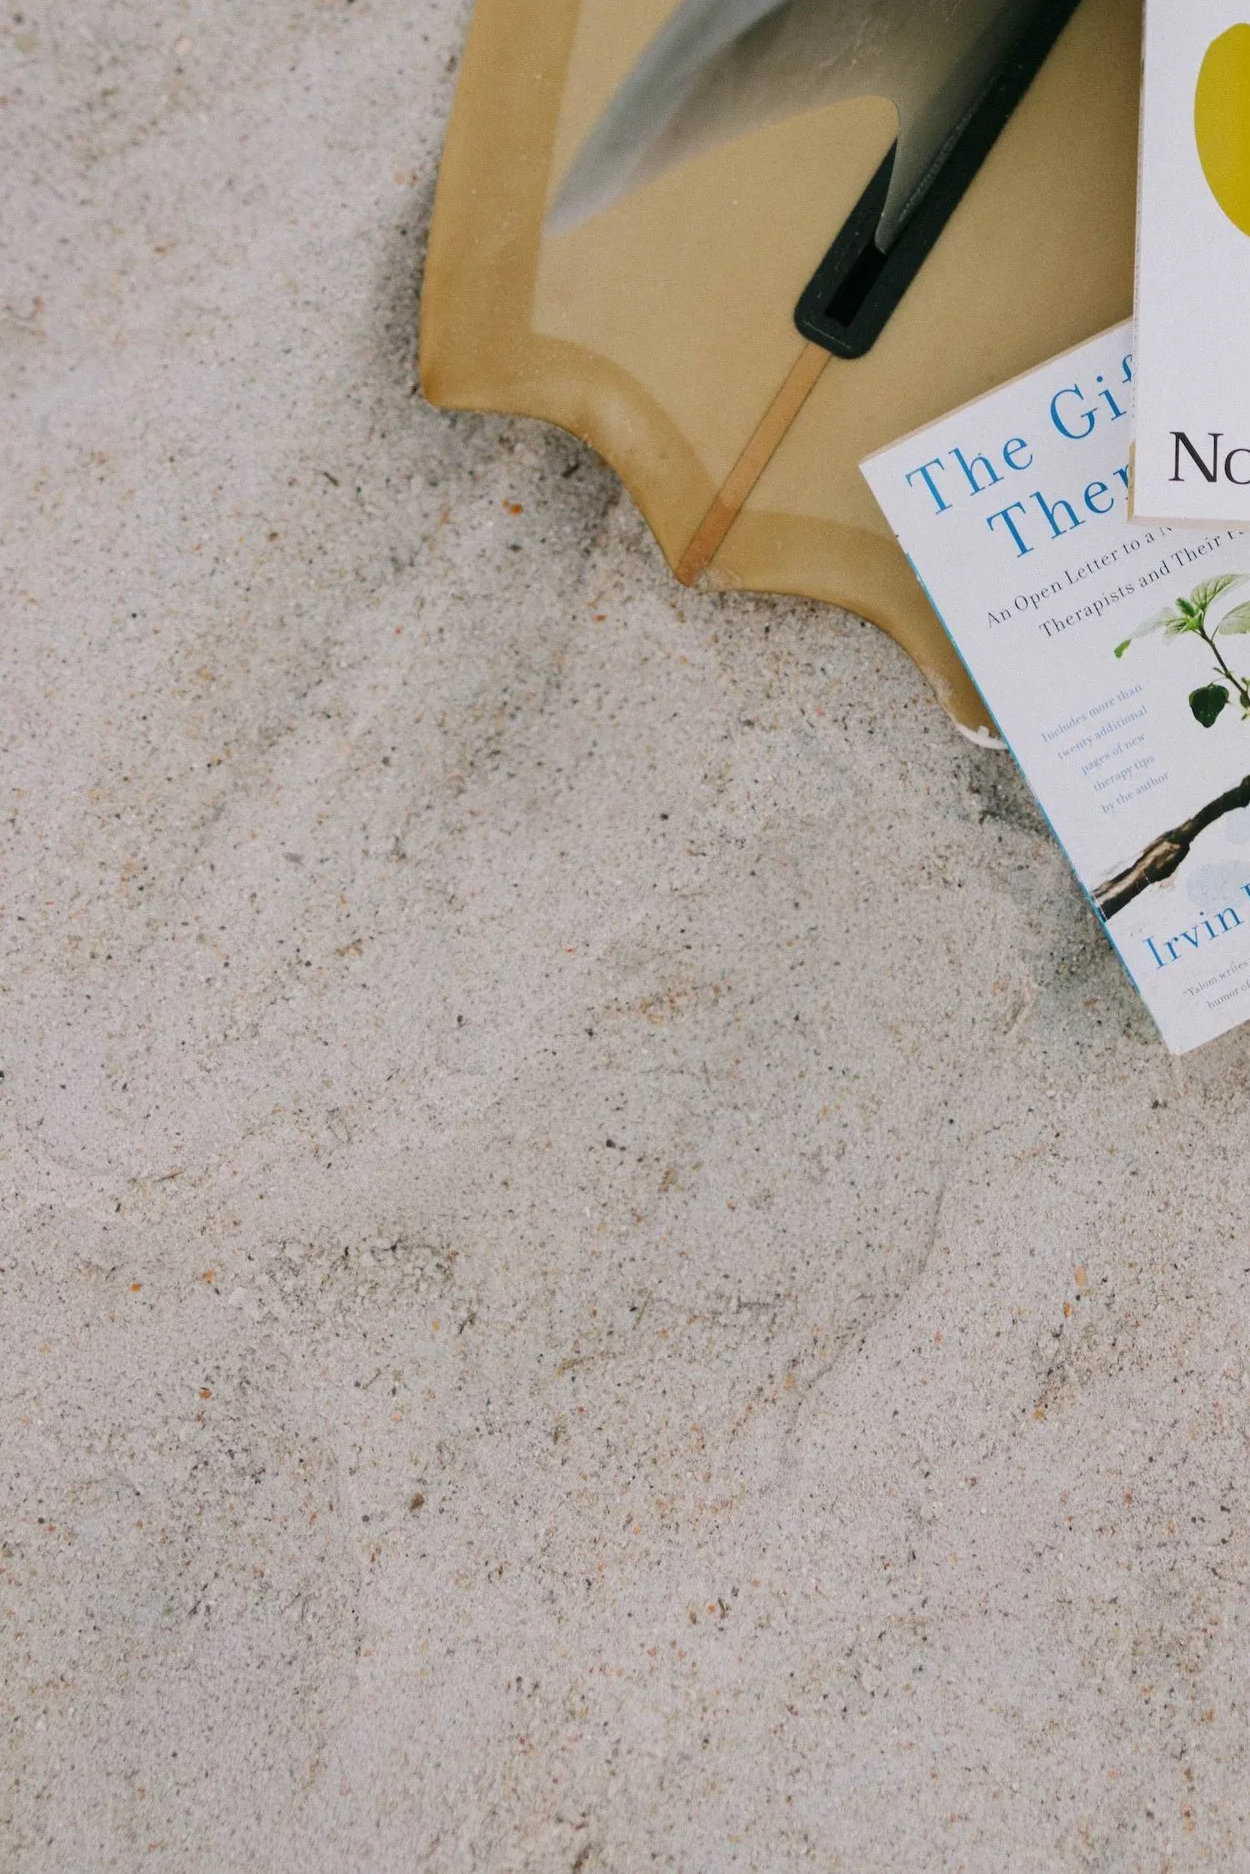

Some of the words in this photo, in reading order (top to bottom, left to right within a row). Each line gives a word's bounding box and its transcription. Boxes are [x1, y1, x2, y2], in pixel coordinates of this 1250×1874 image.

[903, 435, 1035, 515] The
[1047, 351, 1132, 442] Gif
[987, 608, 1012, 627] An
[1013, 581, 1062, 611] Open
[1063, 549, 1118, 585] Letter
[1121, 539, 1141, 555] to
[1037, 583, 1135, 637] Therapists
[1137, 559, 1171, 588] and
[1170, 534, 1220, 567] Their
[1041, 710, 1087, 742] Includes
[1087, 697, 1115, 718] more
[1115, 681, 1143, 702] than
[1056, 736, 1094, 760] twenty
[1092, 703, 1149, 739] additional
[1080, 751, 1113, 775] pages
[1110, 742, 1124, 758] of
[1123, 732, 1145, 750] new
[1091, 764, 1132, 792] therapy
[1132, 751, 1156, 771] tips
[1099, 801, 1116, 814] by
[1115, 789, 1133, 805] the
[1134, 771, 1170, 796] author
[1143, 904, 1243, 969] Irvin
[1205, 987, 1239, 1009] humor
[1217, 960, 1249, 980] writes
